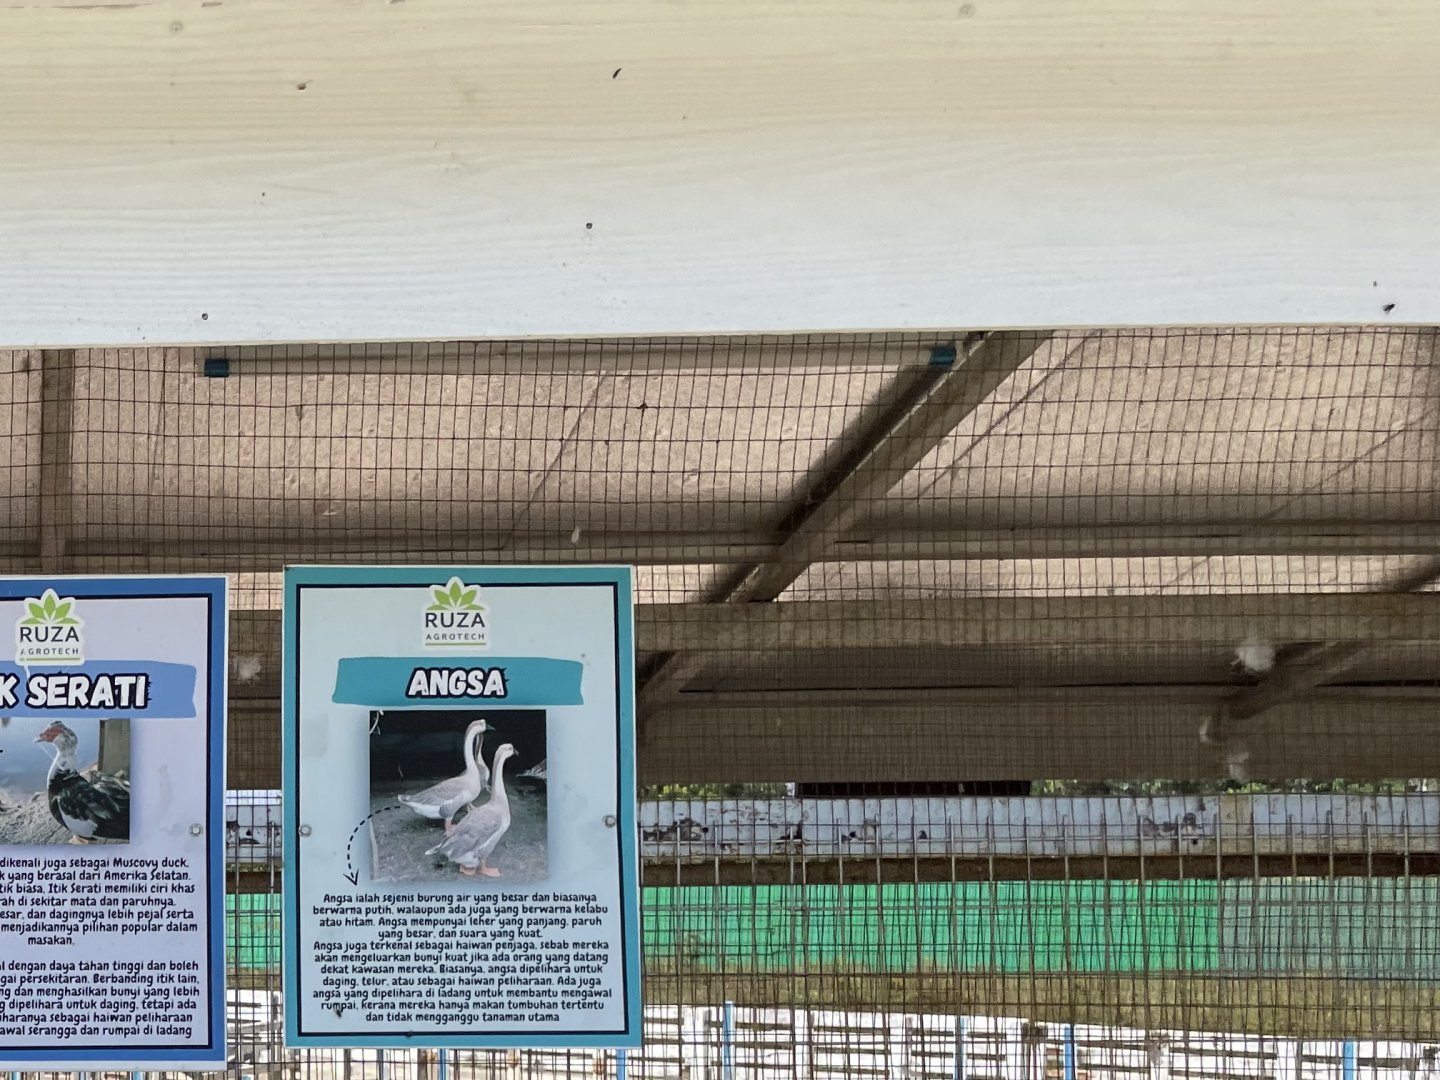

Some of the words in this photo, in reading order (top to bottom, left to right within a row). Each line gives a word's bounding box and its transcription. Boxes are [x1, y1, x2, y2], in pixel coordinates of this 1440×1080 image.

[425, 612, 485, 628] RUZA
[20, 626, 79, 642] RUZA
[408, 669, 507, 698] ANGSA
[25, 675, 147, 707] SERATI
[0, 858, 40, 867] dikenali
[42, 858, 66, 870] juga
[70, 858, 109, 870] sebagai
[113, 858, 158, 870] Muscovy
[8, 874, 33, 883] yang
[37, 871, 76, 880] berasal
[79, 871, 100, 880] dari
[104, 871, 147, 880] Amerika
[323, 894, 352, 905] Angsa
[356, 894, 379, 902] ialah
[383, 893, 414, 905] sejenis
[418, 893, 453, 905] burung
[456, 893, 471, 902] air
[474, 895, 498, 904] yang
[502, 893, 531, 902] besar
[532, 893, 550, 902] dan
[553, 893, 597, 904] biasanya
[378, 931, 403, 940] yang
[438, 929, 457, 937] dan
[490, 931, 515, 940] yang
[366, 1012, 384, 1021] dan
[387, 1012, 413, 1021] tidak
[416, 1013, 479, 1025] mengganggu
[482, 1013, 525, 1021] tanaman
[528, 1013, 560, 1021] utama
